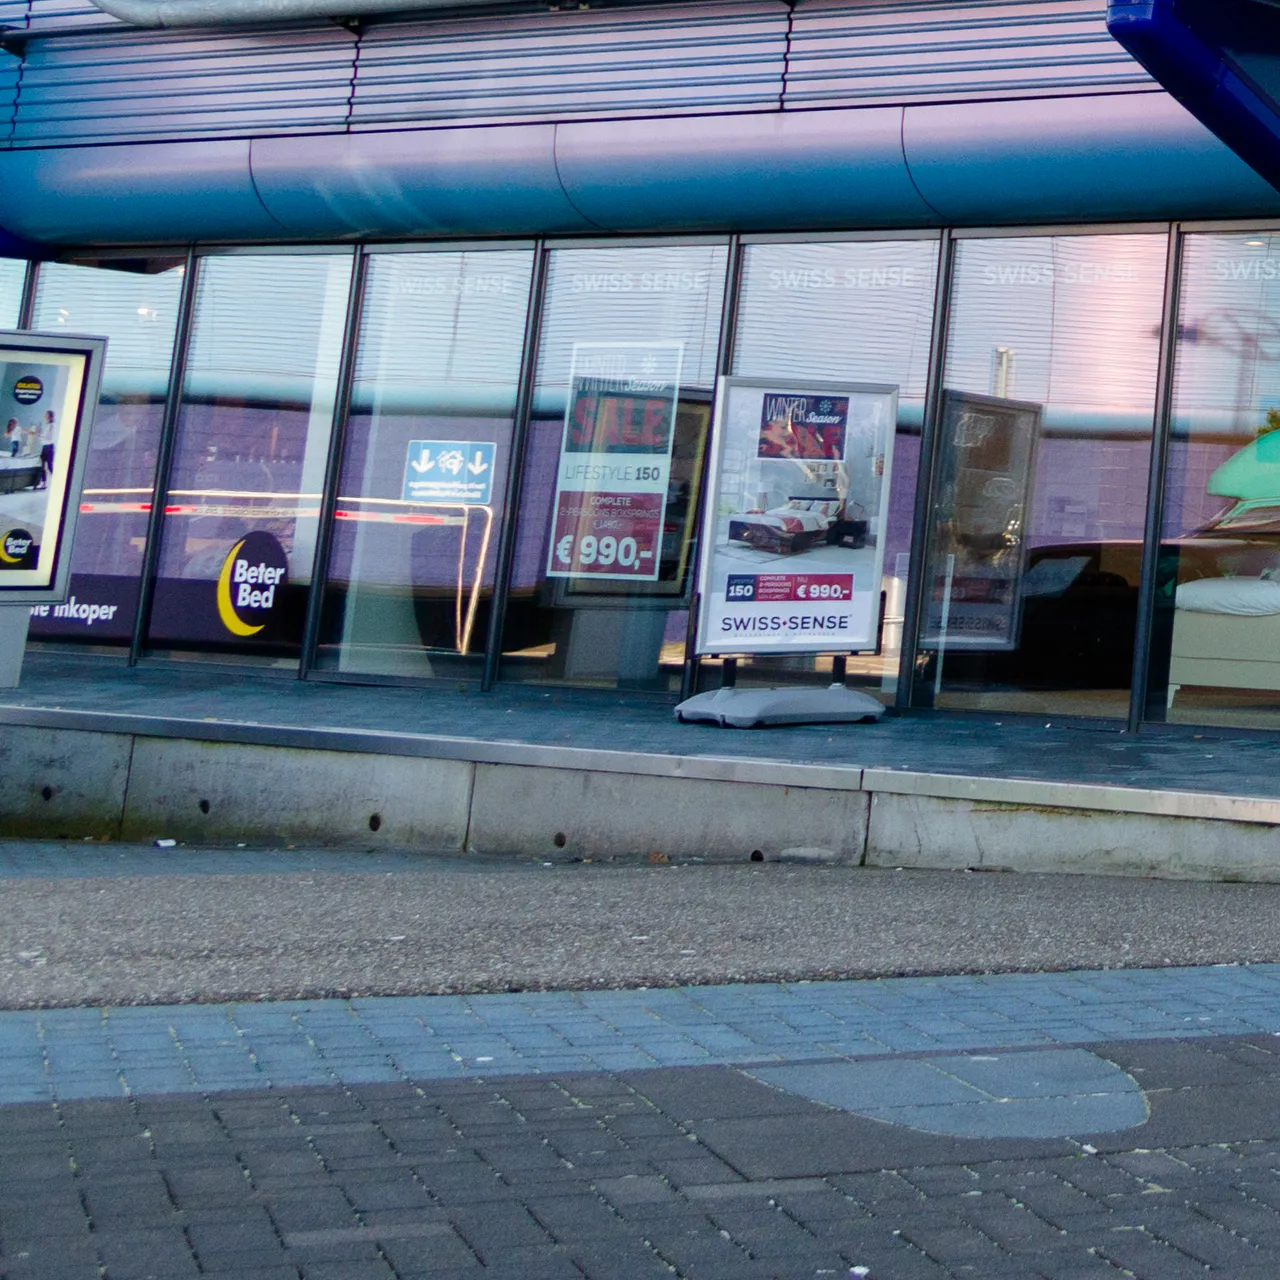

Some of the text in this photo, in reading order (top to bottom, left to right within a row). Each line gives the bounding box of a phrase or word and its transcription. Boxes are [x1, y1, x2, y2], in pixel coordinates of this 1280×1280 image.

[571, 273, 634, 293] SWISS
[768, 266, 917, 289] SWISS SENSE
[983, 265, 1053, 286] SWISS
[765, 395, 807, 424] WINTER
[806, 410, 844, 425] Season
[571, 397, 667, 446] SALE
[565, 464, 661, 481] LIFESTYLE 150
[590, 496, 632, 507] COMPLETE
[556, 535, 653, 571] € 990,-
[234, 558, 287, 586] Beter
[236, 583, 274, 610] Bed
[728, 584, 754, 597] 150
[797, 584, 807, 598] €
[809, 584, 850, 599] 990,-
[720, 614, 849, 632] SWISS SENSE
